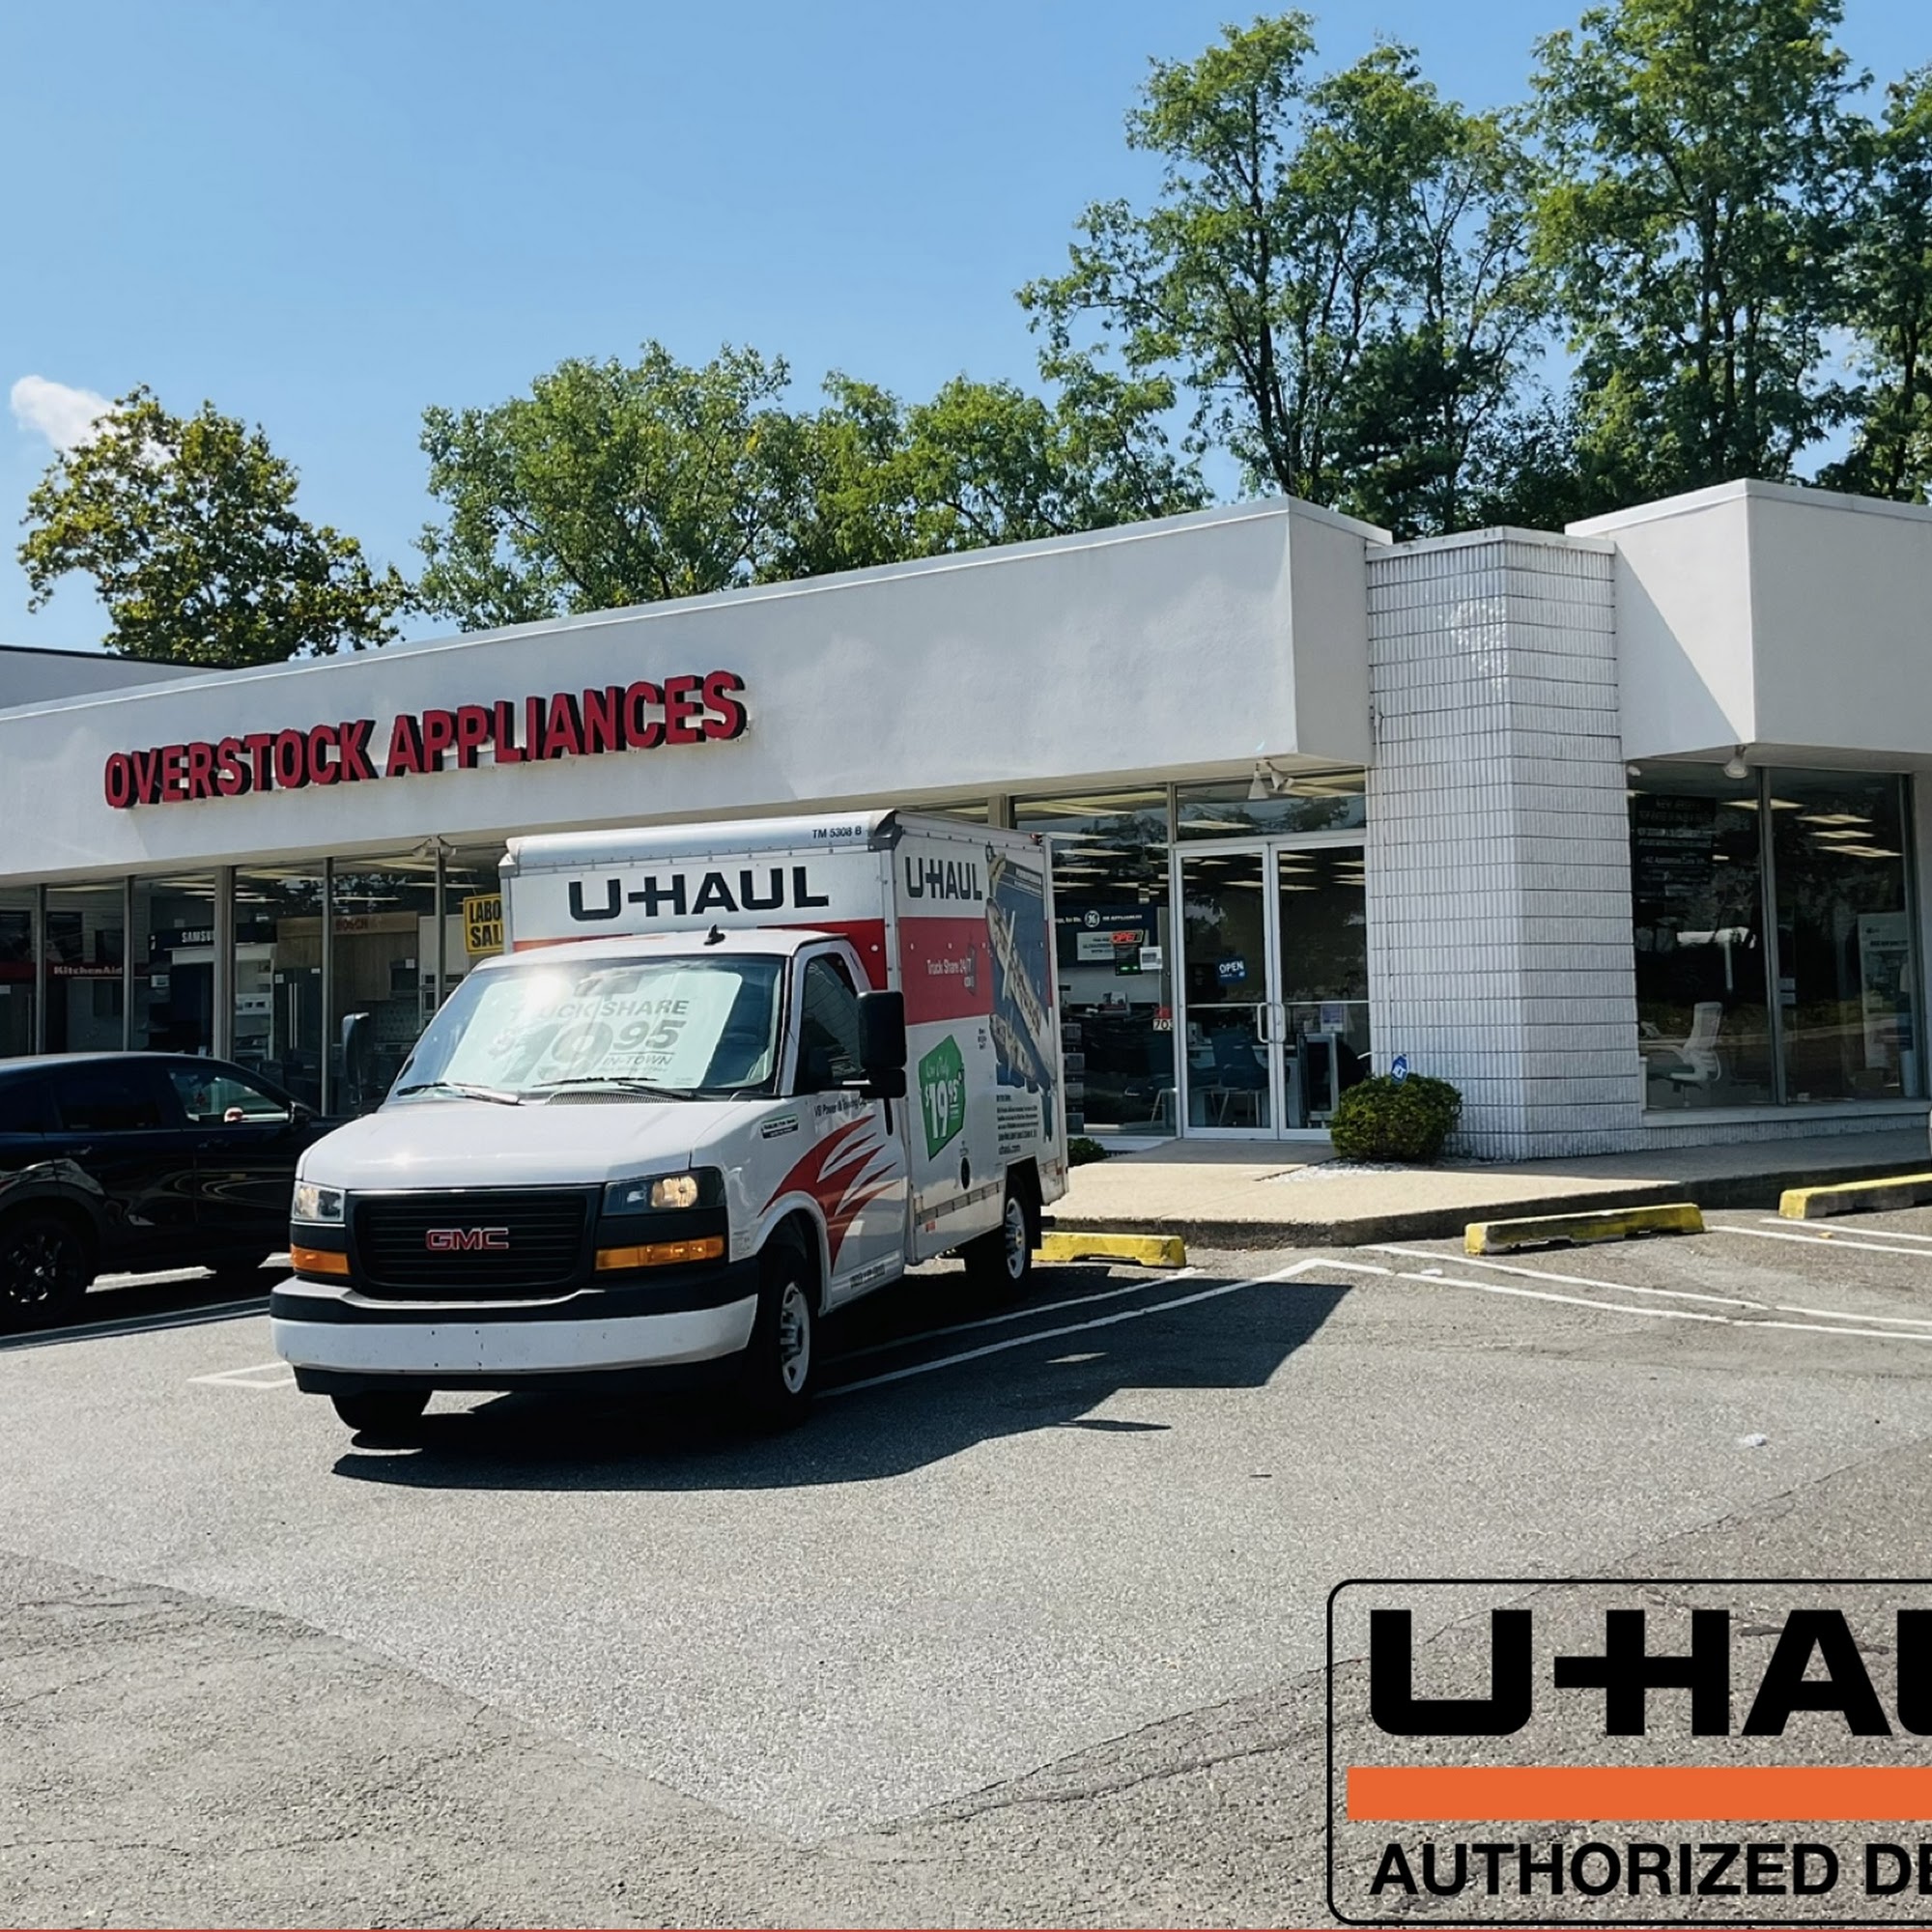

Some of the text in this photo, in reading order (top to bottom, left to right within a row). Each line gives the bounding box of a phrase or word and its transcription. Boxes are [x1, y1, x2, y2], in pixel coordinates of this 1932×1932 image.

[105, 671, 747, 809] OVERSTOCK APPLIANCES
[812, 829, 827, 838] TM
[855, 826, 862, 836] B
[905, 856, 982, 900] U-HAUL
[569, 866, 829, 922] U-HAUL
[470, 923, 504, 948] SAL
[53, 966, 123, 975] KitchenAid
[1218, 960, 1244, 974] OPEN
[601, 1000, 689, 1016] SHARE
[426, 1228, 509, 1250] GMC
